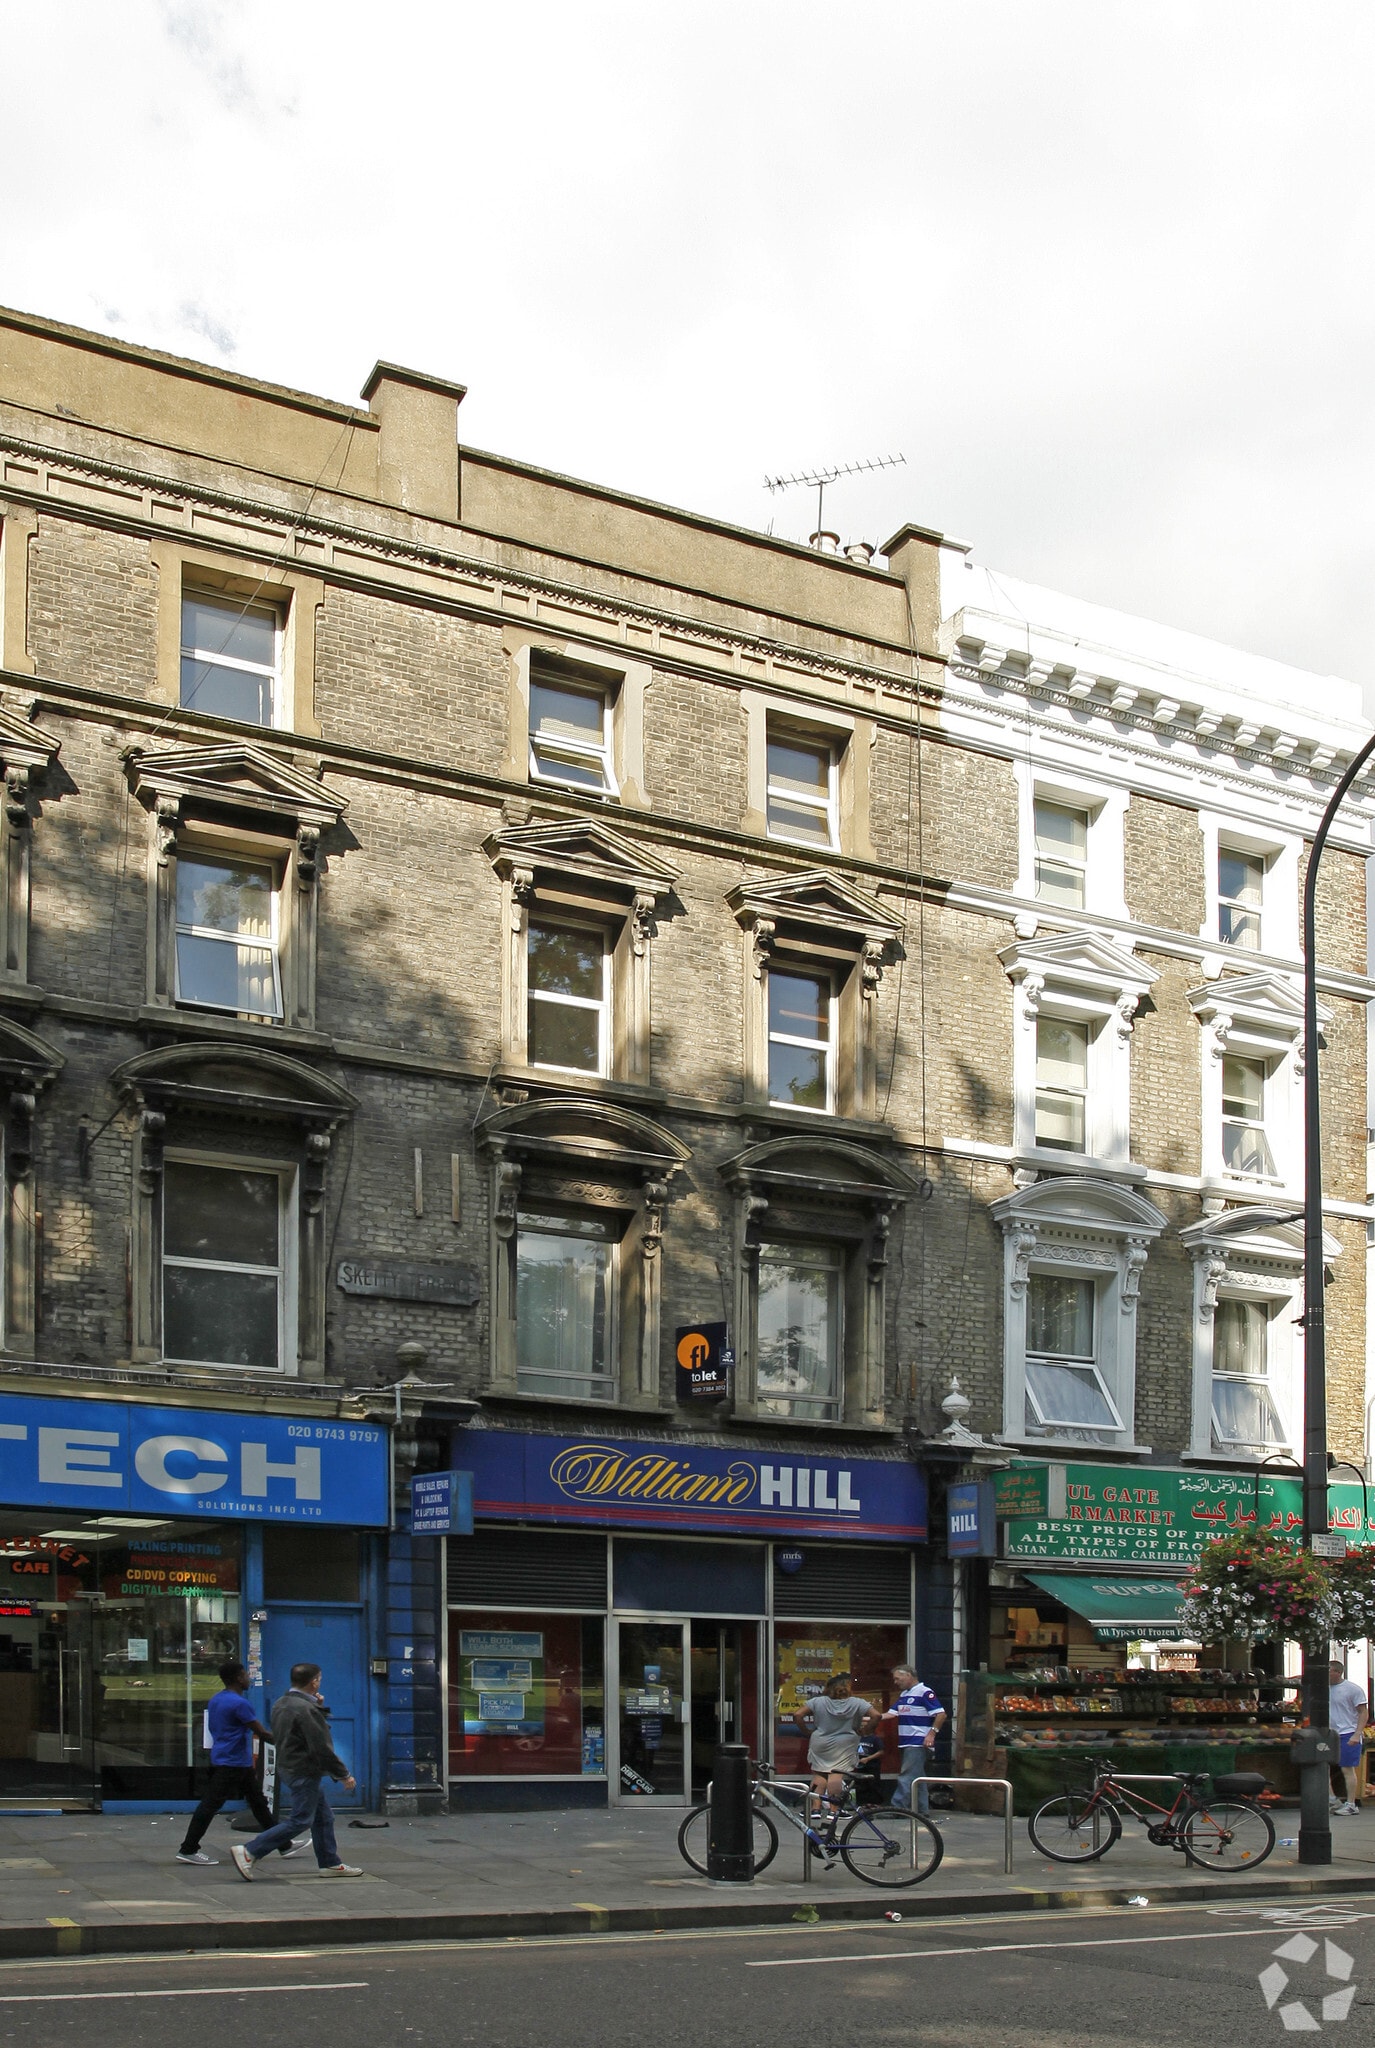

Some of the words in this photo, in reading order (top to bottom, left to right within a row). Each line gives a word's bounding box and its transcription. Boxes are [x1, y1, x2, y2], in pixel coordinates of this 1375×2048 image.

[691, 1373, 701, 1382] to
[702, 1370, 717, 1381] let
[288, 1425, 311, 1438] 020
[315, 1428, 345, 1441] 8743
[350, 1430, 379, 1443] 9797
[550, 1445, 757, 1505] William
[760, 1465, 860, 1511] HILL
[1103, 1487, 1159, 1504] GATE
[198, 1501, 263, 1512] SOLUTIONS
[269, 1505, 296, 1514] INFO
[302, 1507, 322, 1516] LTD
[951, 1513, 978, 1533] HILL
[1037, 1522, 1083, 1533] BEST
[1092, 1525, 1158, 1537] PRICES
[1165, 1529, 1187, 1539] OF
[1020, 1533, 1059, 1544] ALL
[1066, 1536, 1127, 1547] TYPES
[1135, 1539, 1159, 1549] OF
[1008, 1544, 1047, 1555] ASIAN
[1061, 1546, 1118, 1557] AFRICAN
[1131, 1550, 1200, 1561] CARIBBEAN
[12, 1561, 49, 1574] CAFE
[126, 1569, 165, 1581] CD/DVD
[169, 1571, 217, 1583] COPYING
[121, 1583, 163, 1596] DIGITAL
[167, 1586, 223, 1598] SCANNING
[1099, 1628, 1109, 1636] All
[1111, 1628, 1135, 1637] Types
[1137, 1627, 1146, 1636] Of
[1148, 1628, 1175, 1637] Frozen
[468, 1636, 488, 1644] WILL
[490, 1636, 513, 1644] BOTH
[795, 1649, 834, 1657] FREE
[620, 1766, 637, 1781] DEBIT
[636, 1779, 654, 1795] CARD
